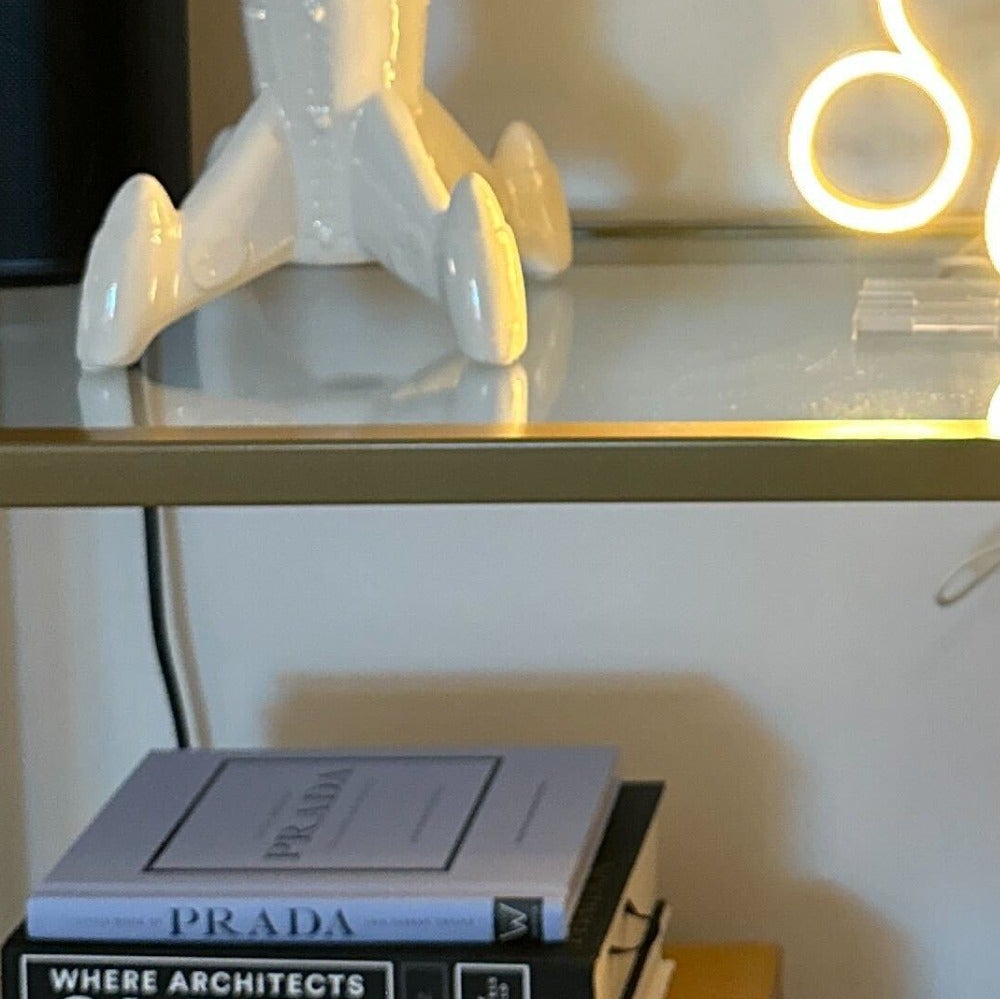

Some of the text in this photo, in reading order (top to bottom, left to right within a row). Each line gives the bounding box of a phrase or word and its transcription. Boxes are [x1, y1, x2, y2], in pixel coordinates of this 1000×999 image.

[263, 767, 355, 860] PRADA
[168, 905, 355, 937] PRADA
[49, 967, 366, 999] WHERE ARCHITECTS
